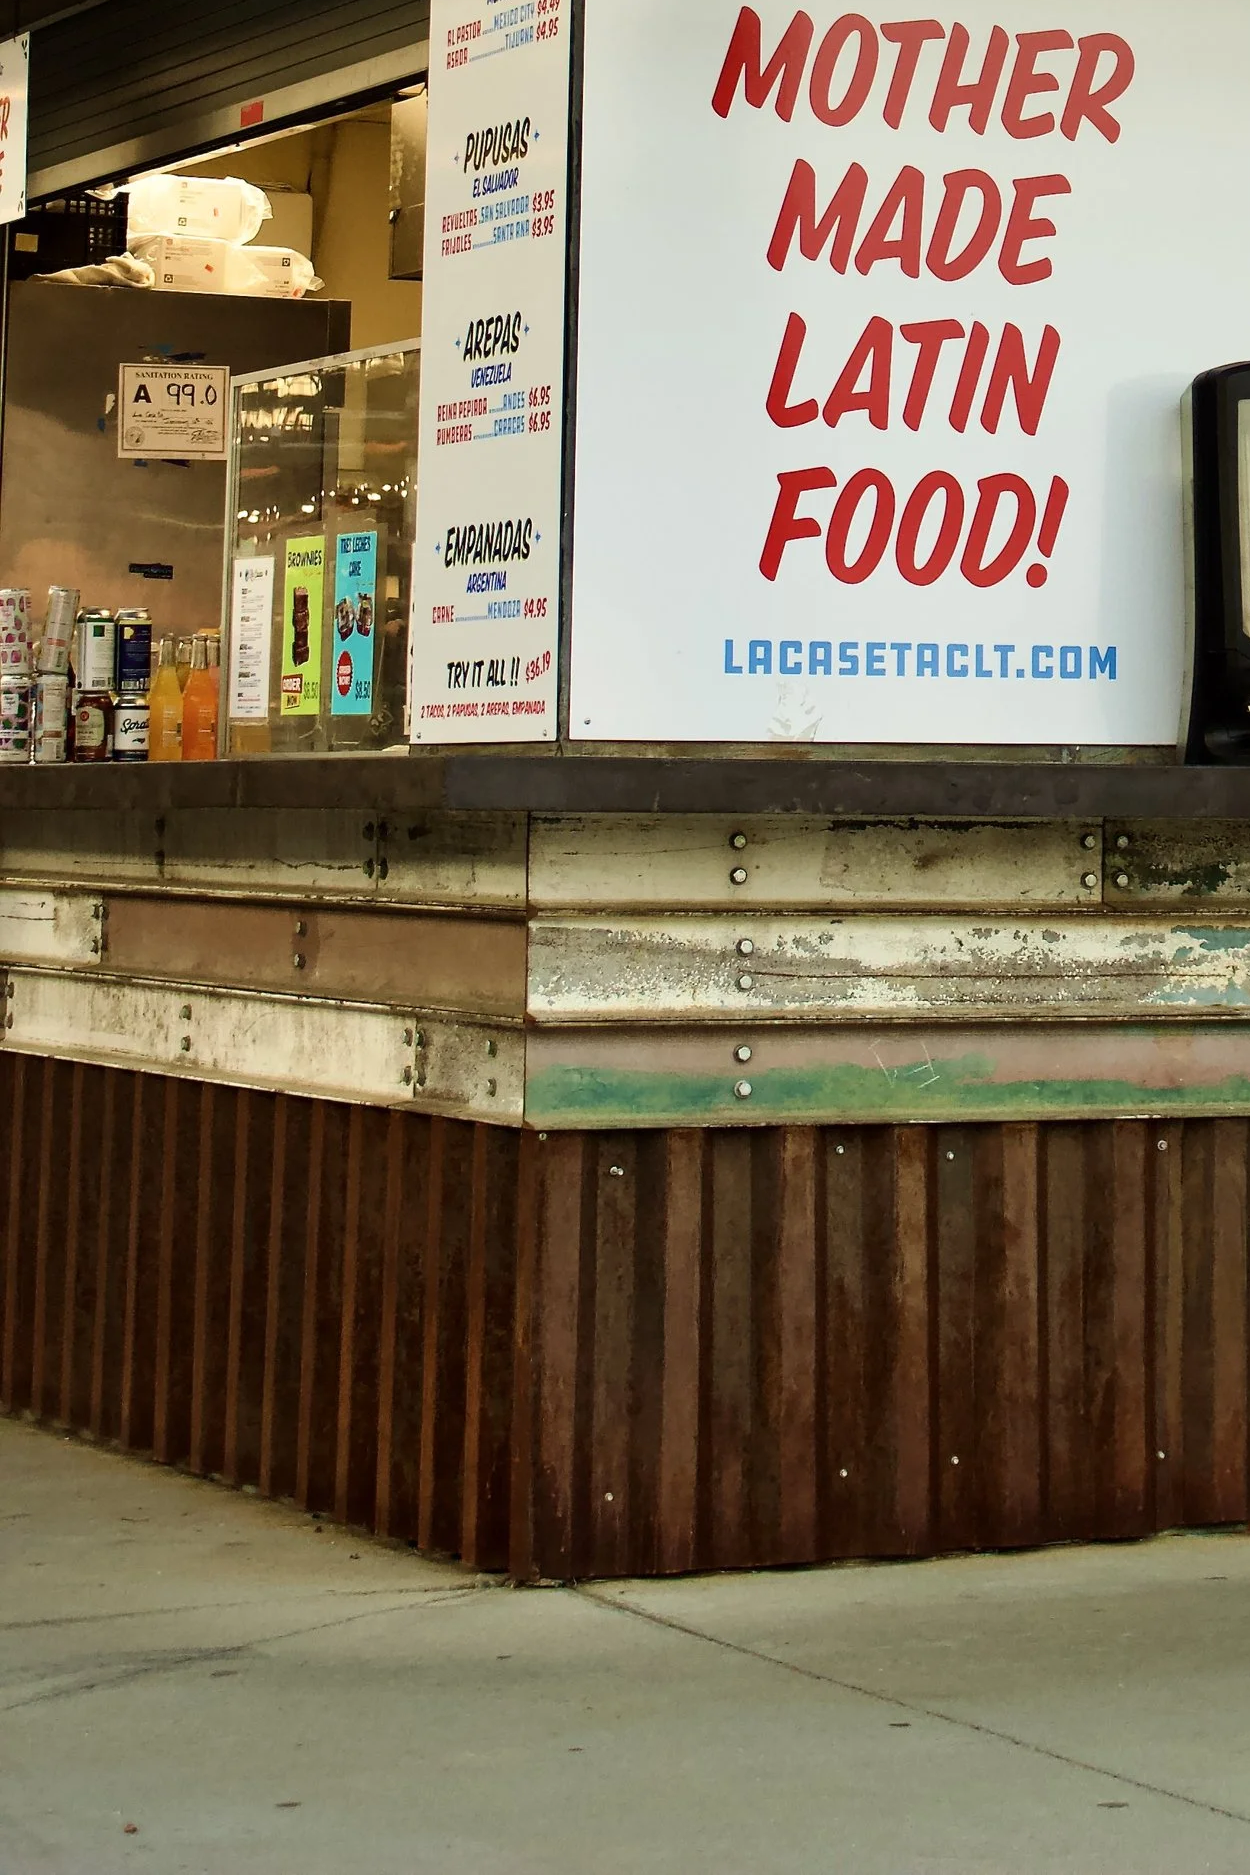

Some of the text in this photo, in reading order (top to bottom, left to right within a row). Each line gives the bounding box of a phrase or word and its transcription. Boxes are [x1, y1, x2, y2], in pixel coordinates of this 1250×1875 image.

[446, 29, 456, 48] AL
[457, 19, 482, 45] PASTOR
[494, 7, 519, 32] MEXICO
[519, 1, 536, 24] CITY
[446, 16, 560, 71] ASADA TIJUANA $4.95
[710, 5, 1137, 145] MOTHER
[463, 116, 531, 175] PUPUSAS
[472, 167, 520, 199] EL SALVADOR
[441, 189, 556, 234] REVUELTAS SAN SALVADOR $3.95
[766, 157, 1073, 287] MADE
[441, 214, 555, 258] FRIJOLES SANTA ANA $3.95
[462, 310, 523, 362] AREPAS
[132, 382, 218, 407] A 99.0
[135, 371, 214, 381] SANITATION RATING
[470, 361, 513, 389] VENEZUELA
[765, 311, 1062, 437] LATIN
[437, 384, 552, 423] REINA PEPIADA ANDES $6.95
[436, 410, 552, 447] RUMBERAS CARACAS $6.95
[444, 517, 533, 569] EMPANADAS
[758, 466, 1070, 589] FOOD!
[287, 548, 323, 569] BROWNIES
[466, 570, 507, 594] ARGENTINA
[432, 597, 549, 625] CARNE MENDOZA $4.95
[446, 661, 470, 689] TRY
[471, 659, 485, 689] IT
[486, 659, 507, 688] ALL
[524, 650, 552, 685] $36.19
[723, 638, 1119, 681] LACASETACLT.COM
[420, 705, 425, 719] 2
[425, 704, 446, 720] TACOS,
[446, 704, 452, 718] 2
[480, 703, 486, 717] 2
[486, 701, 511, 717] AREPAS,
[511, 700, 546, 716] EMPANADA
